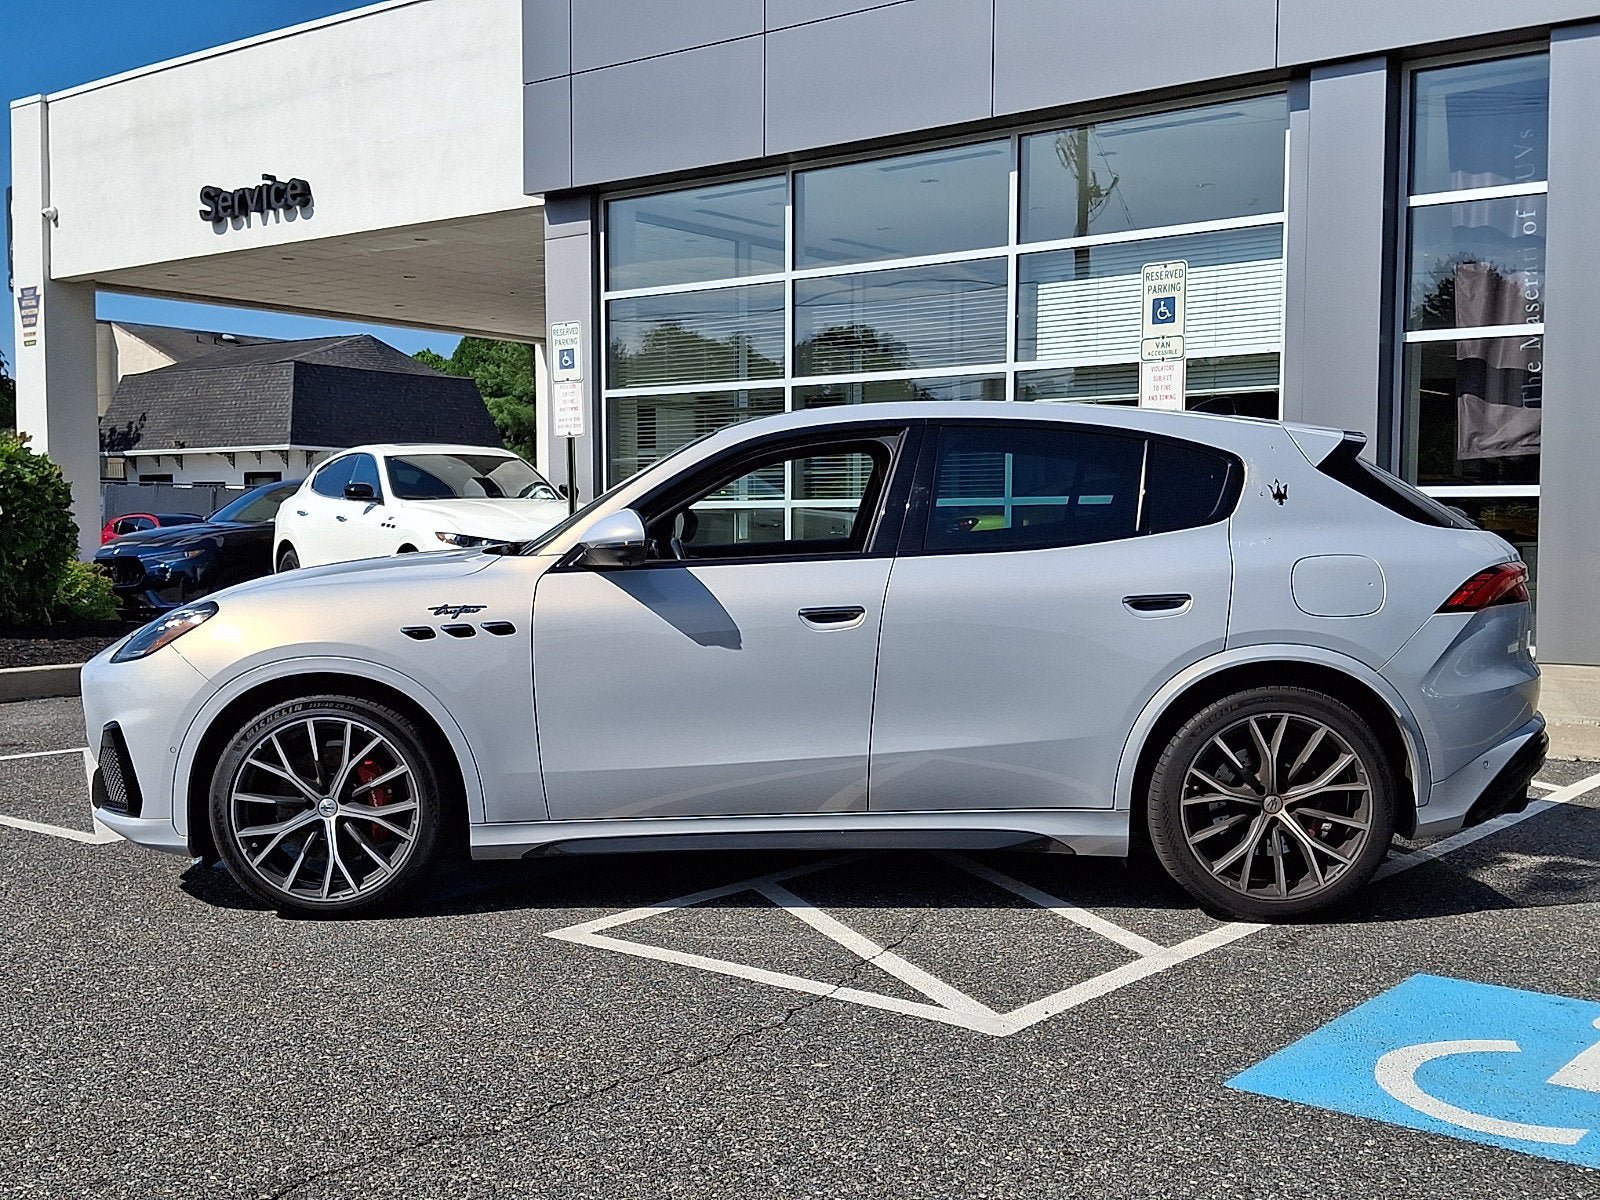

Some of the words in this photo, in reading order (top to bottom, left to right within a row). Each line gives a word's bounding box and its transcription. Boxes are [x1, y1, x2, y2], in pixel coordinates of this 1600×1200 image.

[1513, 128, 1535, 180] UVs
[199, 174, 314, 221] Service
[1515, 210, 1537, 235] of
[1145, 268, 1184, 281] RESERVED
[1147, 282, 1182, 295] PARKING
[1518, 247, 1542, 351] Maserati
[552, 327, 579, 337] RESERVED
[554, 337, 578, 346] PARKING
[1147, 348, 1178, 357] ACCESSIBLE
[1155, 340, 1171, 349] VAN
[1521, 361, 1543, 408] The
[245, 703, 303, 740] MICHELIN
